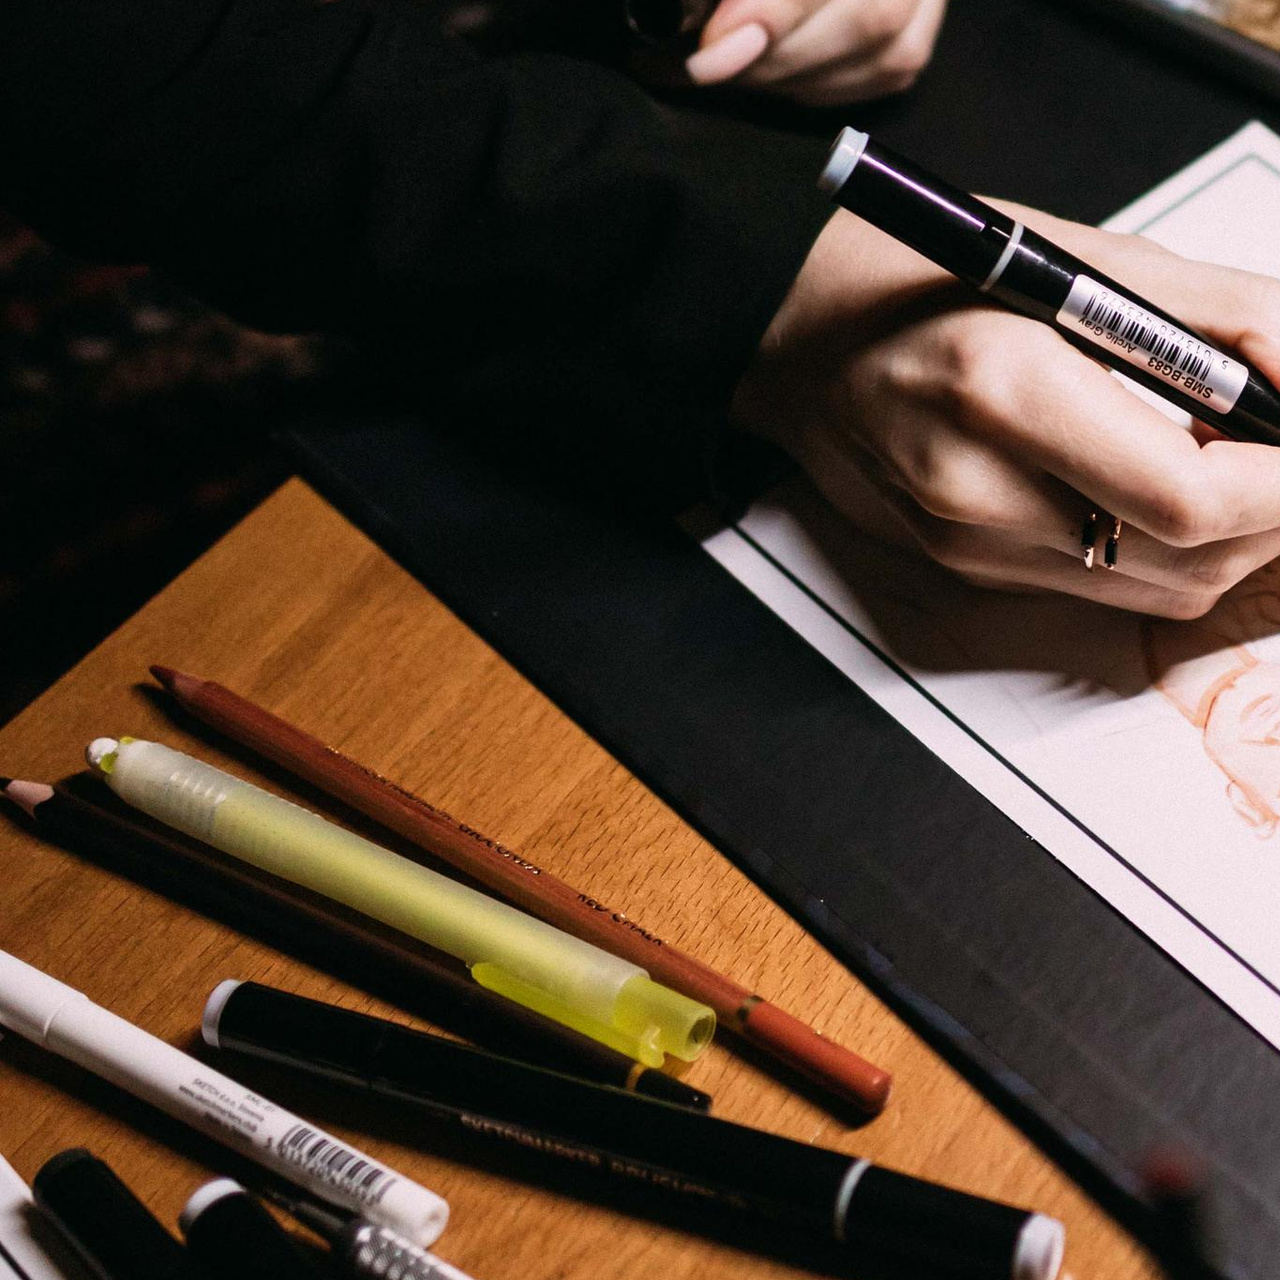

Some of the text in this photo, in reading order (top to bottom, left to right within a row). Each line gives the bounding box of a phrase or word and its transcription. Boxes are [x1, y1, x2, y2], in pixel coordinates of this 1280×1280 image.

[1078, 315, 1214, 399] SMB-BG83 Arctic Gray
